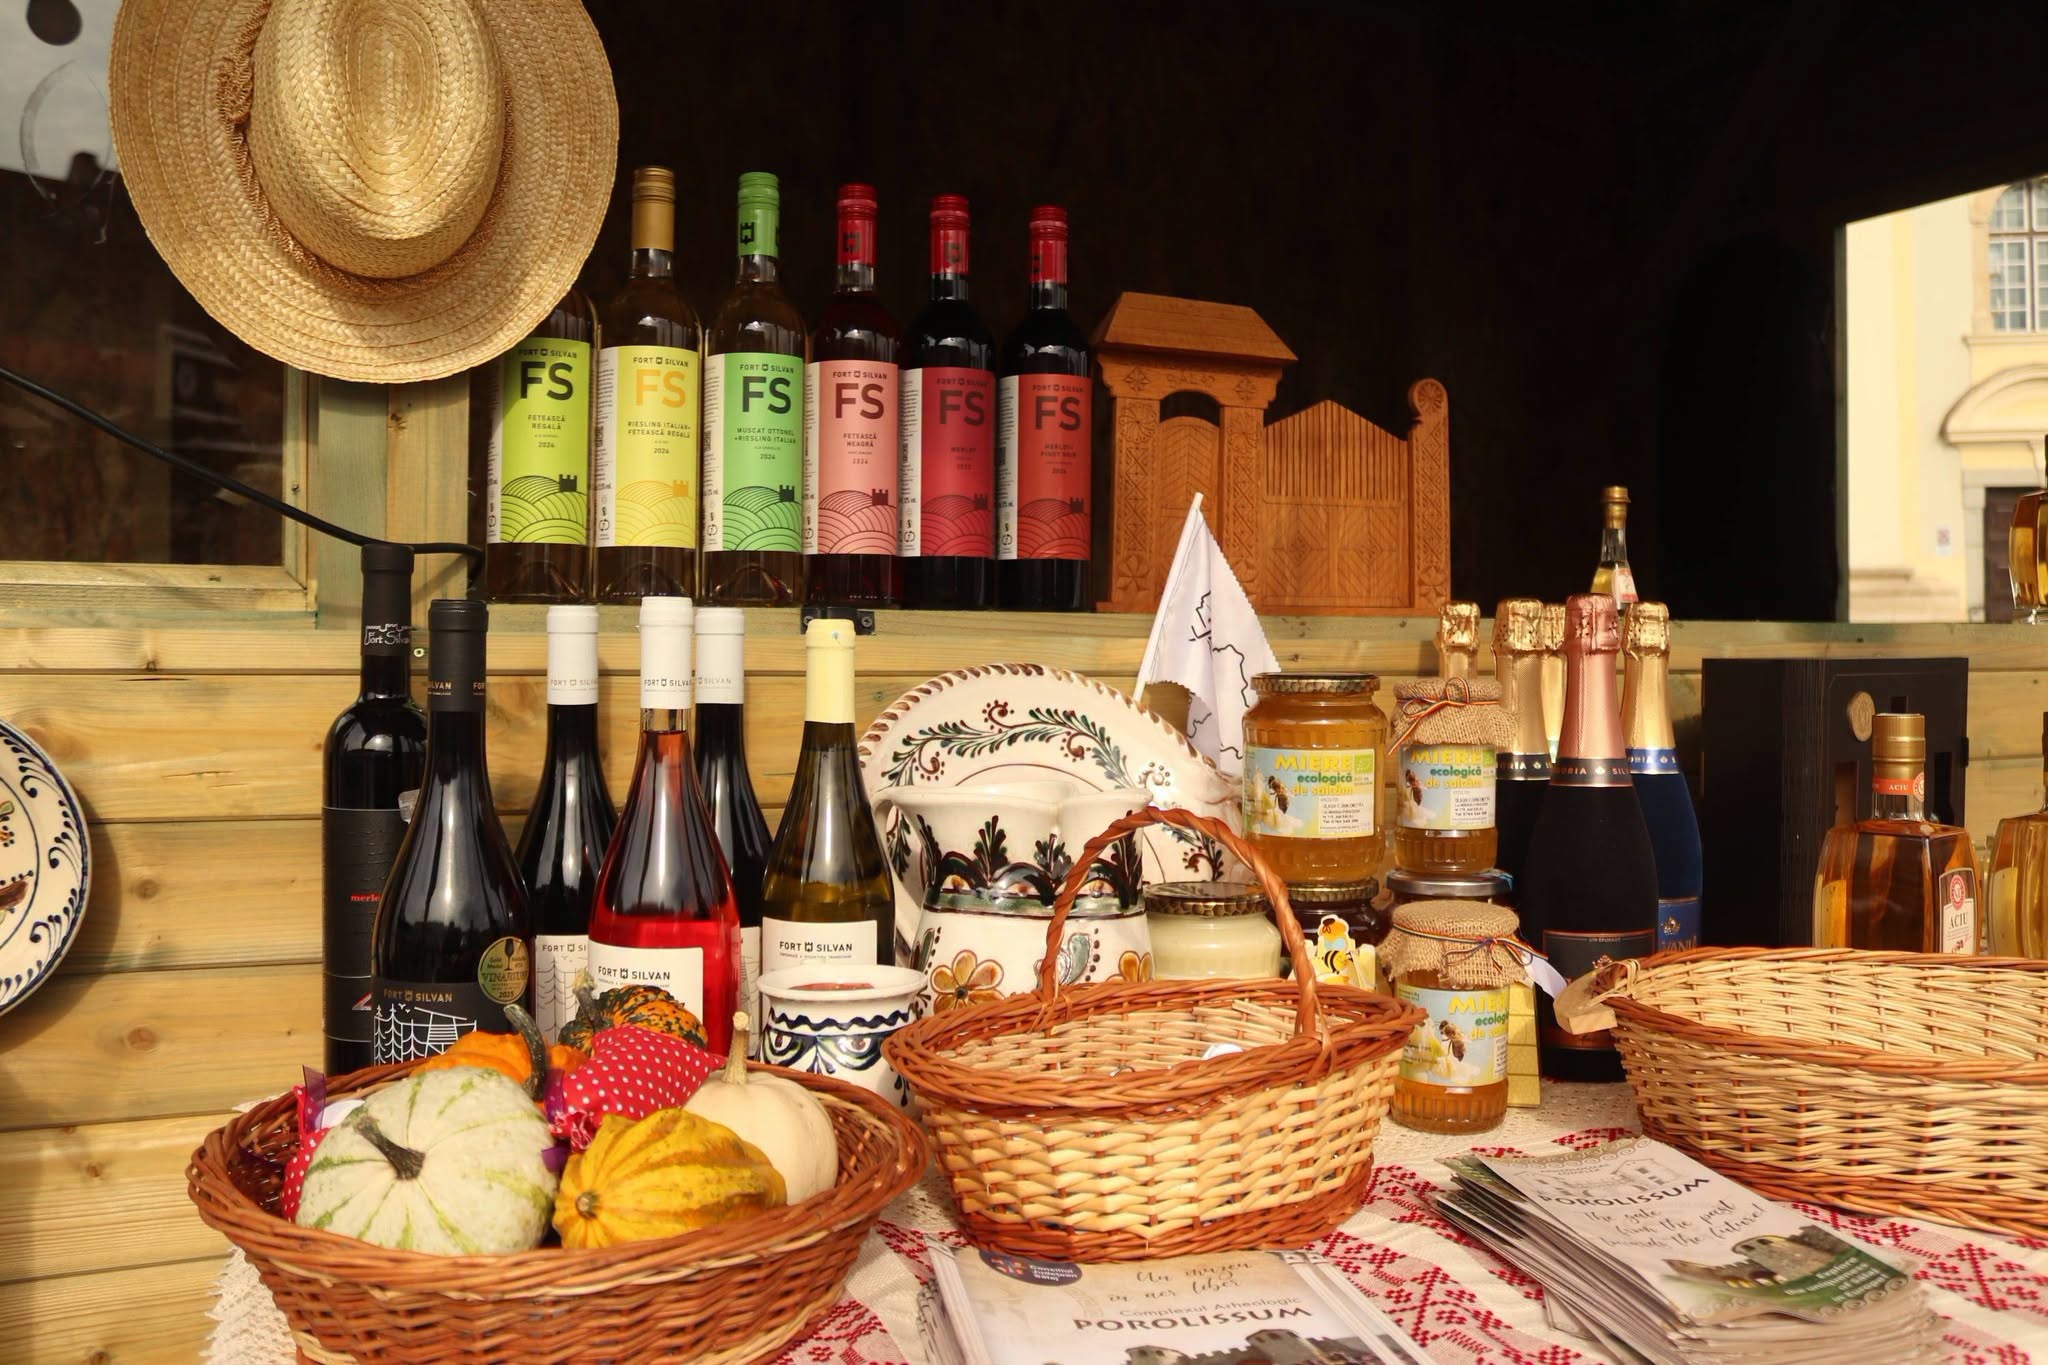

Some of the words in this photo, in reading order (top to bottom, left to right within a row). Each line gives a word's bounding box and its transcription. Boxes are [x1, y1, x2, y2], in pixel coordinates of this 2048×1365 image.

[550, 350, 577, 358] SILVAN
[665, 358, 688, 368] SILVAN
[770, 365, 794, 374] SILVAN
[520, 361, 574, 400] FS
[862, 372, 887, 380] SILVAN
[636, 368, 686, 408] FS
[742, 376, 792, 414] FS
[1032, 384, 1052, 392] FORT
[1062, 385, 1084, 393] SILVAN
[836, 382, 884, 420] FS
[940, 390, 985, 427] FS
[1035, 396, 1081, 431] FS
[627, 420, 661, 428] RIESLING
[550, 679, 567, 687] FORT
[644, 678, 659, 687] FORT
[670, 679, 691, 687] SILVA
[1274, 754, 1352, 772] MIERE
[1410, 748, 1481, 766] MIERE
[1296, 772, 1352, 786] ecologică
[1430, 766, 1482, 778] ecologică
[1949, 912, 1968, 930] ACIU
[542, 944, 564, 952] FORT
[780, 941, 802, 952] FORT
[816, 944, 852, 952] SILVAN
[598, 966, 618, 978] FORT
[632, 971, 670, 980] SILVAN
[383, 988, 402, 998] FORT
[415, 992, 453, 1002] SILVAN
[1538, 1178, 1711, 1206] POROLISSUM
[1192, 1277, 1241, 1294] liber
[1120, 1305, 1207, 1318] Complexul
[1214, 1296, 1302, 1312] Arheologic
[1072, 1306, 1312, 1331] POROLISSUM
